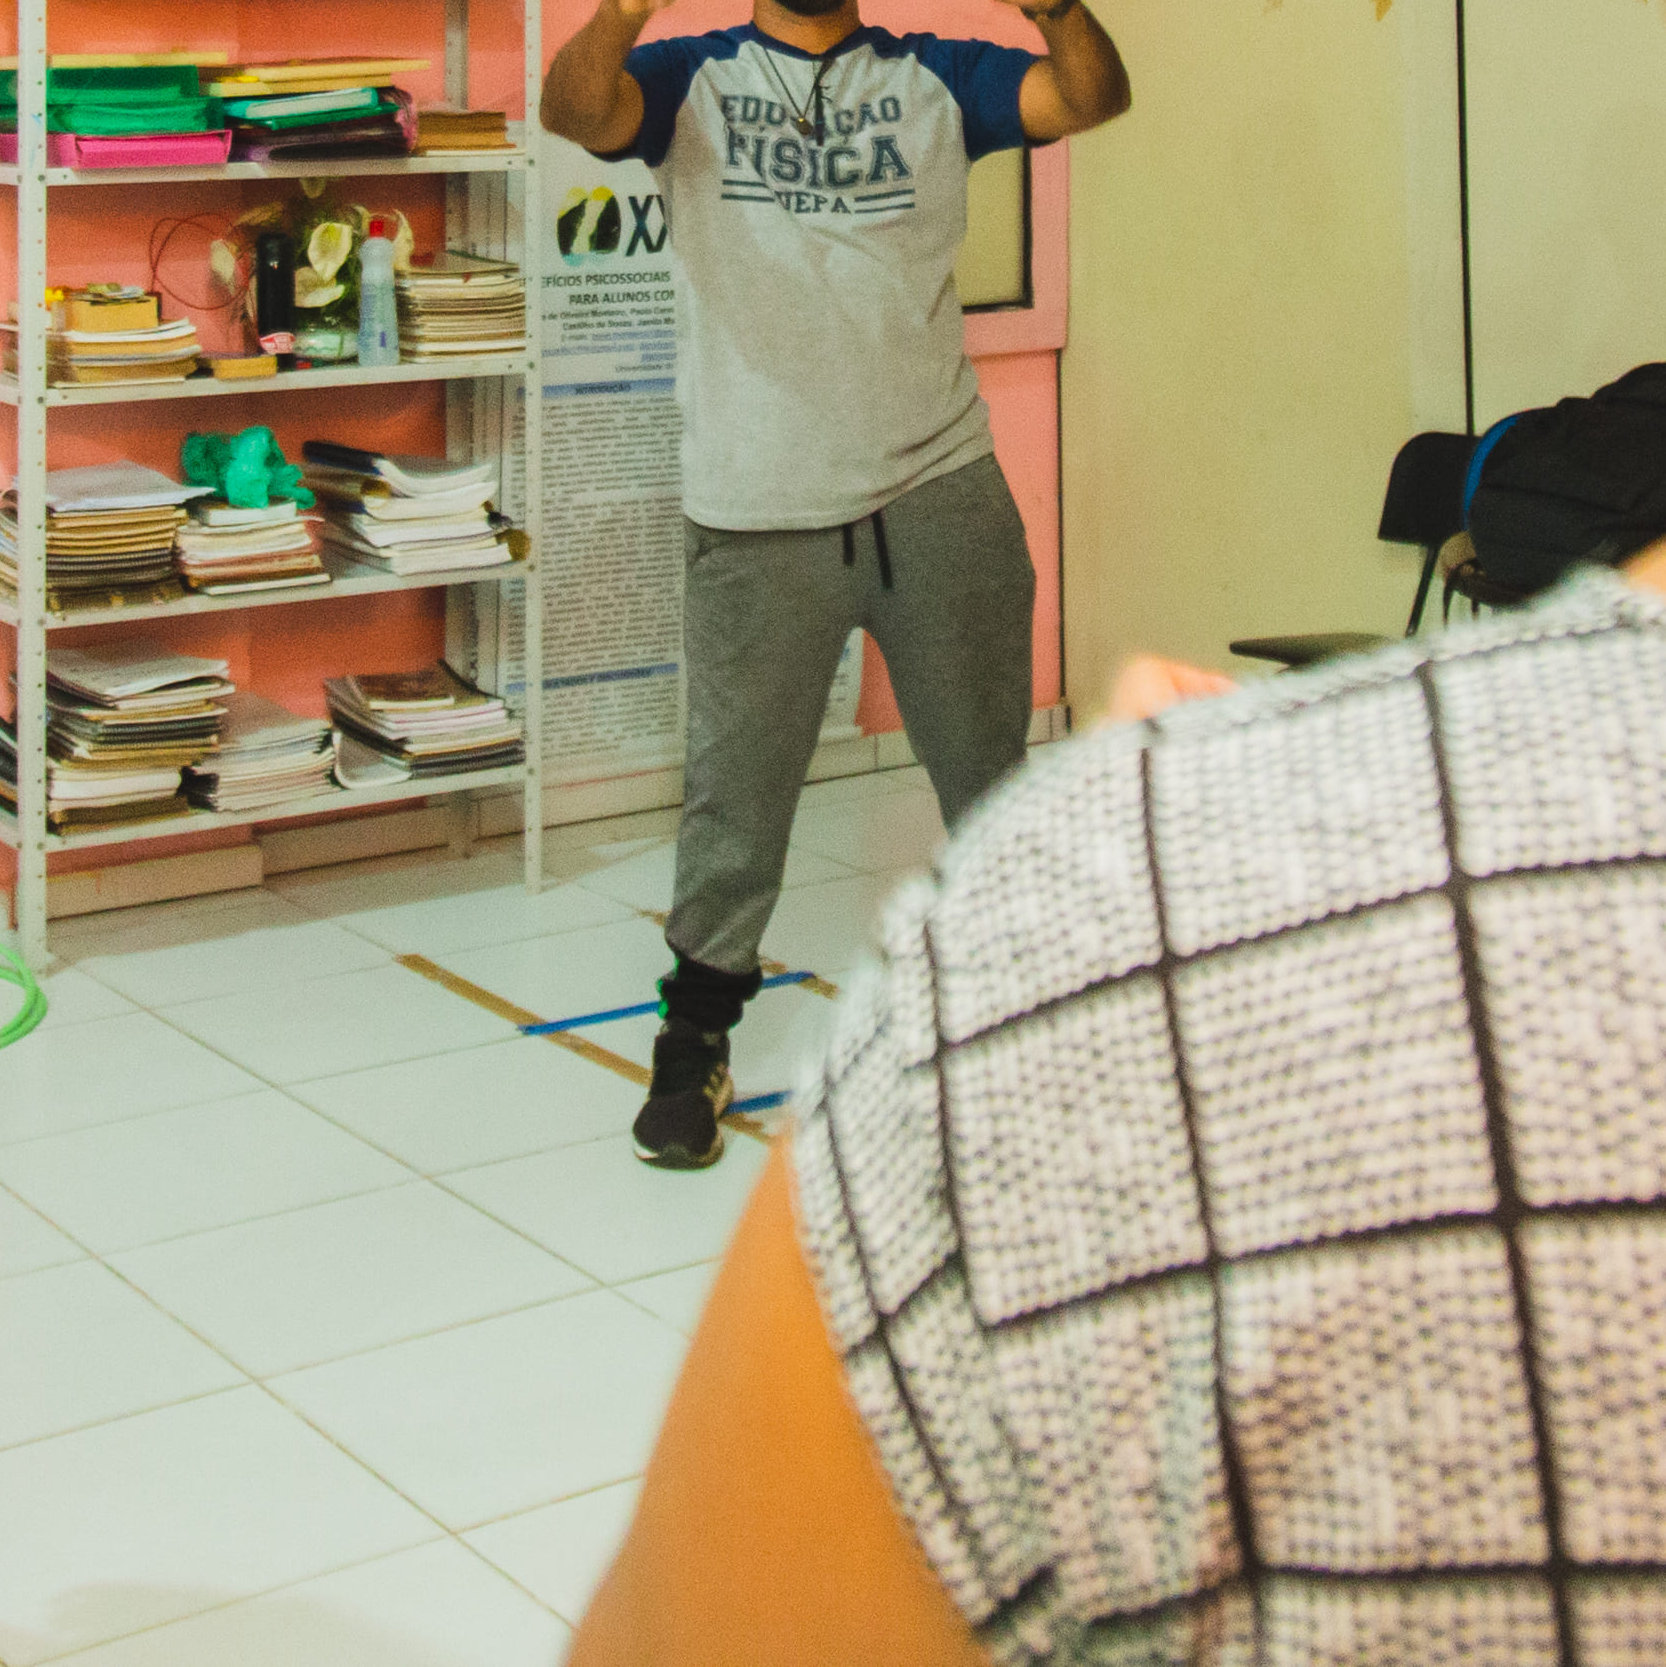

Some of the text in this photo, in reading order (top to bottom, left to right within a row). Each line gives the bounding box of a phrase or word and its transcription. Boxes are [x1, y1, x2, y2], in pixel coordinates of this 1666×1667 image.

[774, 190, 852, 214] UEPA
[585, 270, 672, 286] PSICOSSOCIAIS
[568, 292, 599, 306] PARA
[602, 290, 652, 304] ALUNOS
